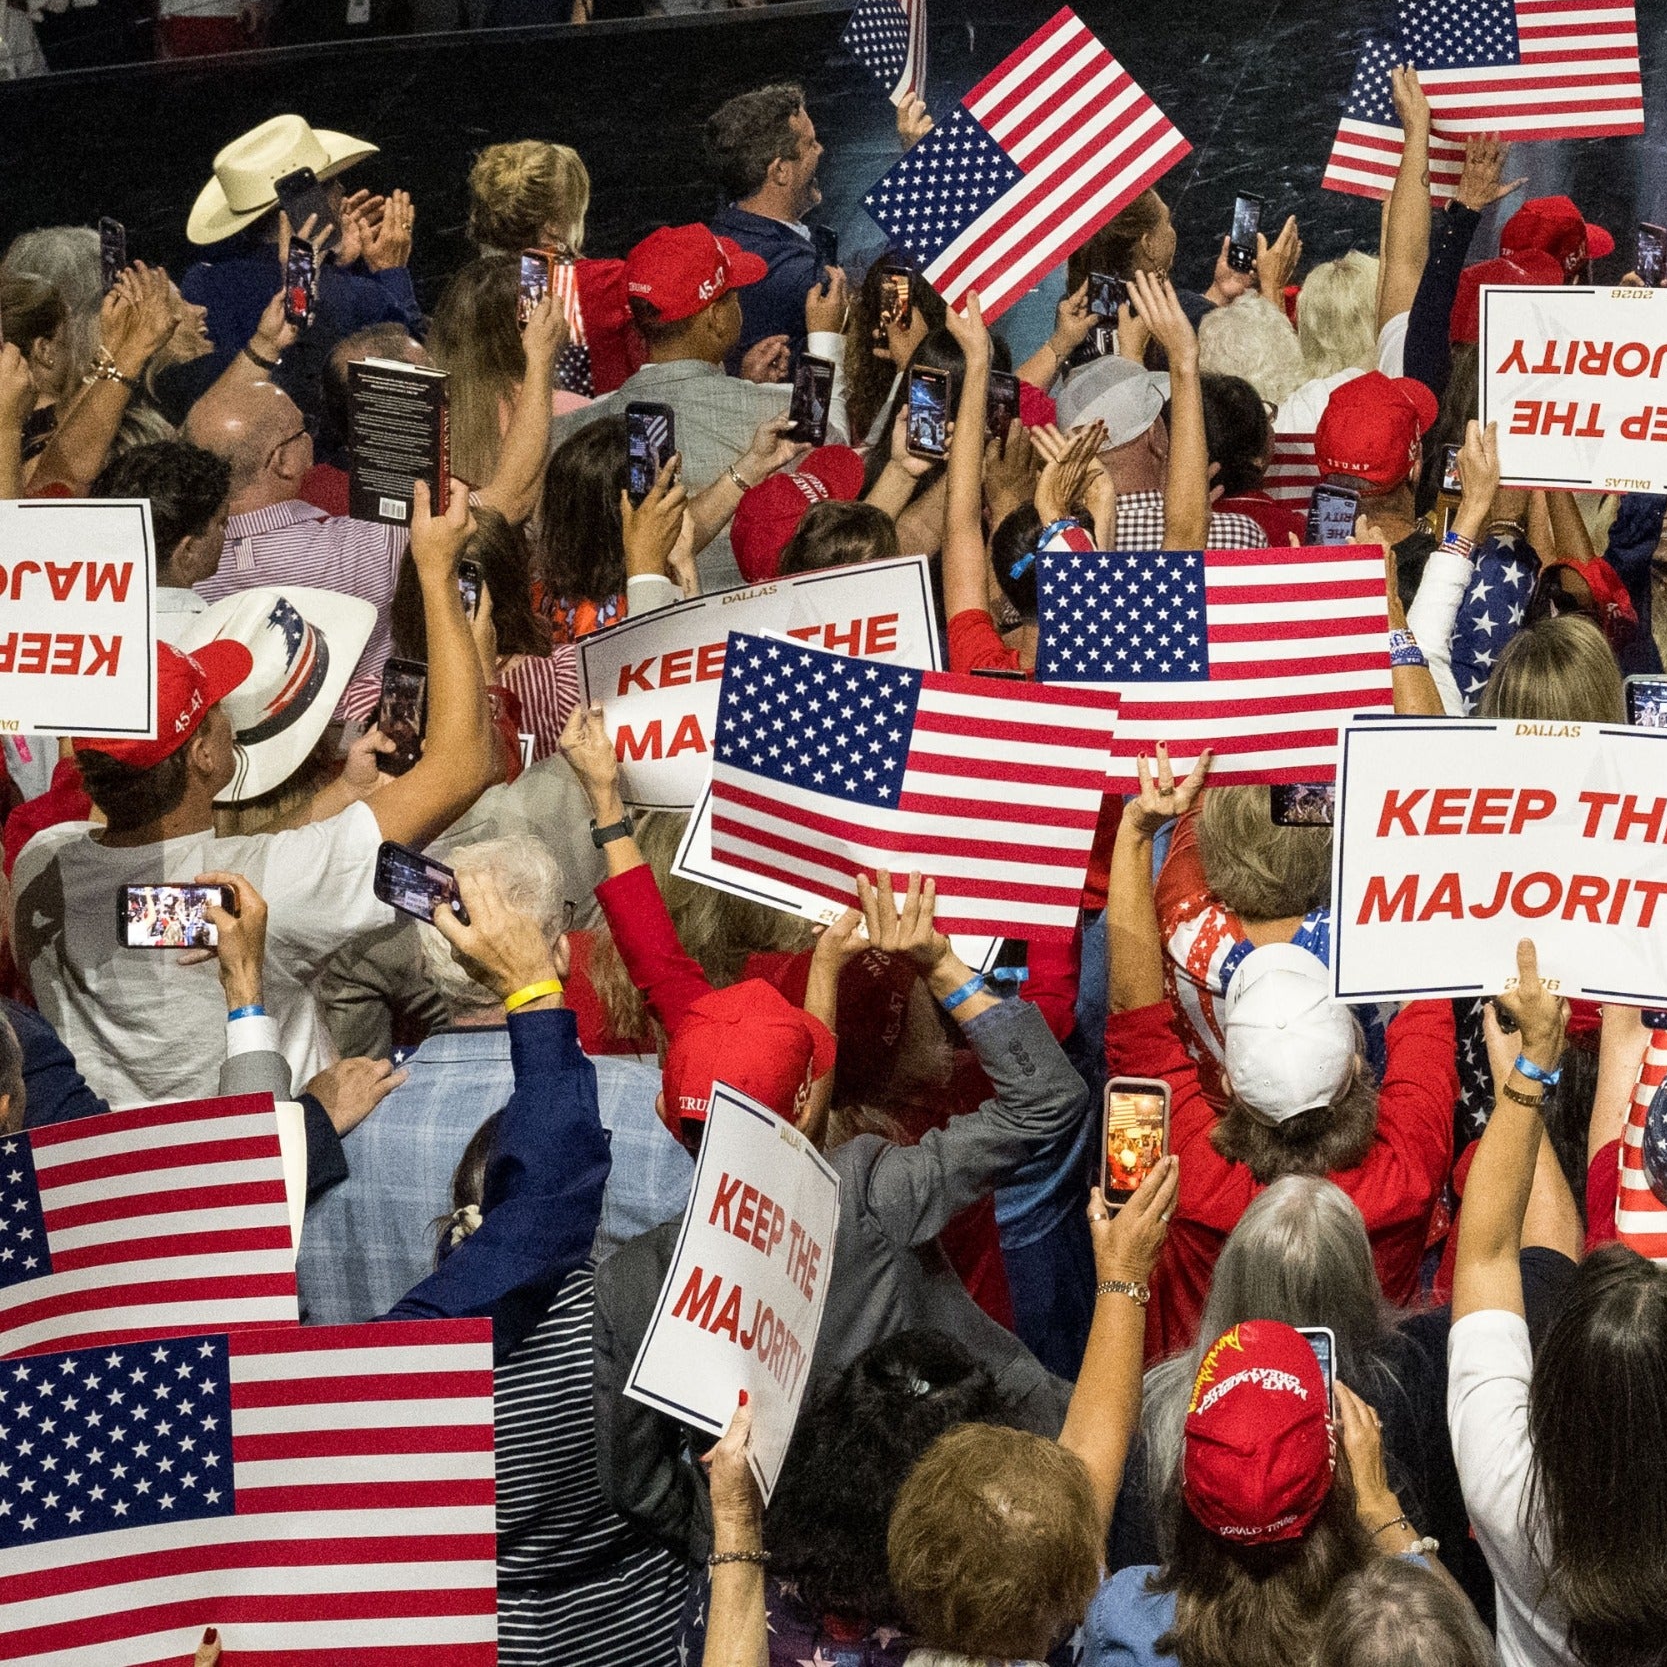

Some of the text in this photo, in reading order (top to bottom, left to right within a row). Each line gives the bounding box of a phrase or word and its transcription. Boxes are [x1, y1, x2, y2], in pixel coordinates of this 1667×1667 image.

[629, 281, 658, 294] TRUMP
[698, 267, 730, 303] 45-47
[1611, 290, 1653, 300] 2026
[1510, 401, 1604, 437] THE
[1327, 458, 1371, 471] TRUMP
[793, 476, 819, 504] MAKE
[1605, 478, 1651, 491] DALLAS
[721, 584, 778, 605] DALLAS
[618, 614, 898, 694] KEE THE
[174, 687, 205, 735] 45-47
[1514, 724, 1581, 739] DALLAS
[1377, 788, 1556, 837] KEEP
[1503, 976, 1560, 991] 226
[679, 1097, 709, 1113] TRU
[709, 1174, 821, 1299] KEEP THE
[671, 1265, 806, 1404] MAJORITY
[1263, 1376, 1308, 1401] MAKE
